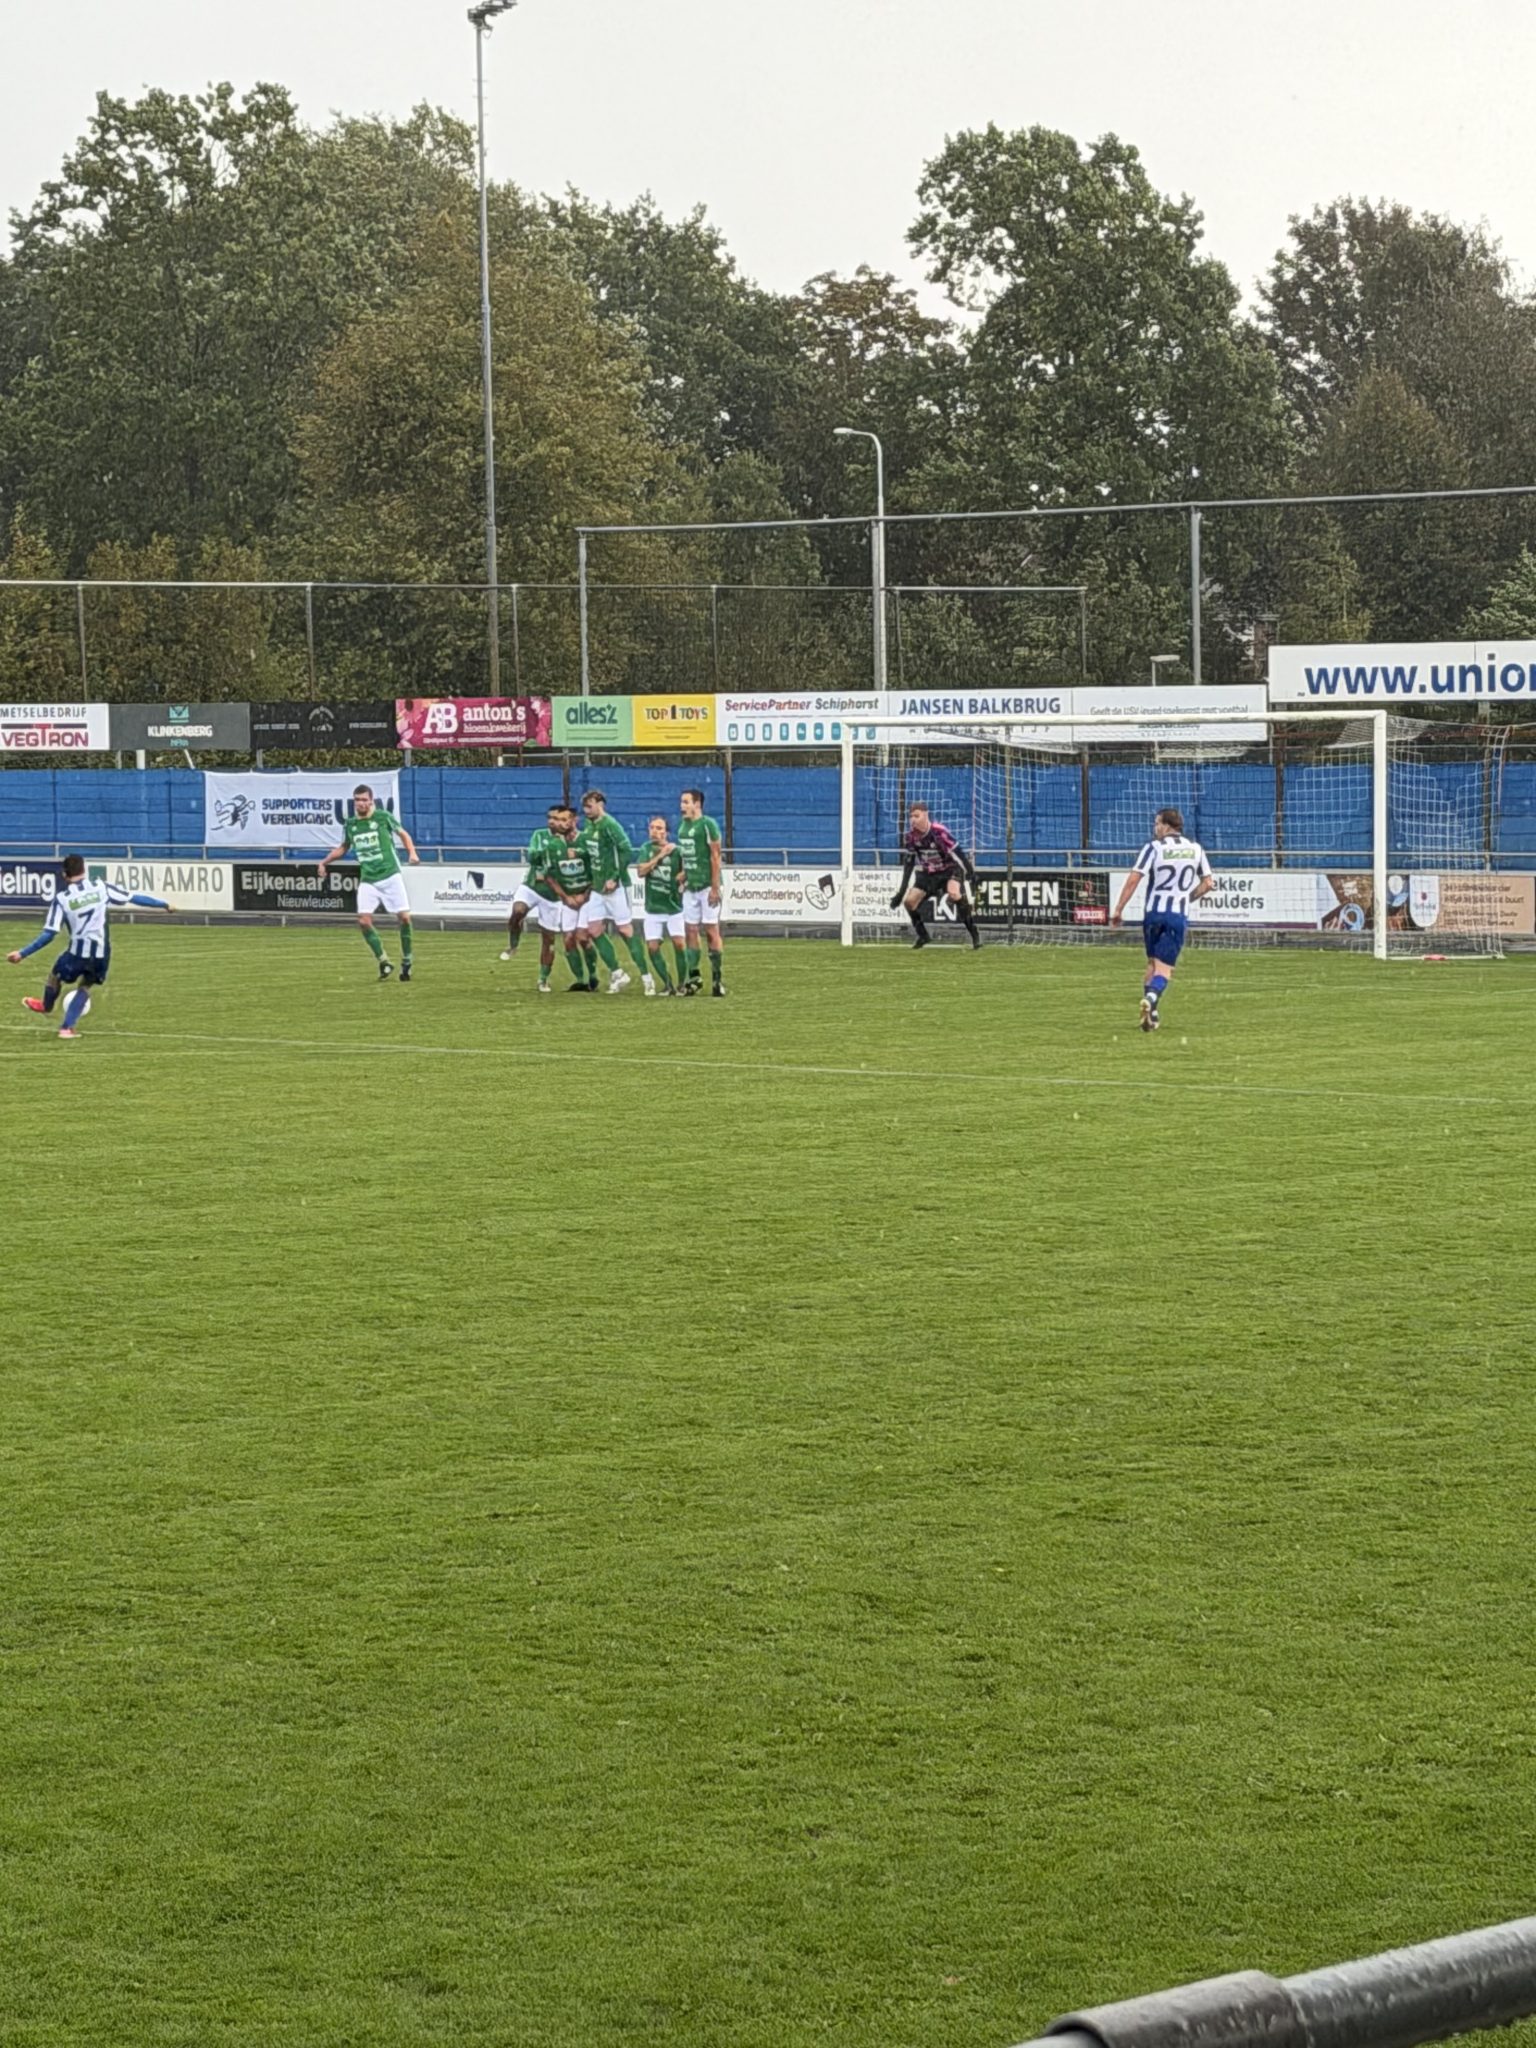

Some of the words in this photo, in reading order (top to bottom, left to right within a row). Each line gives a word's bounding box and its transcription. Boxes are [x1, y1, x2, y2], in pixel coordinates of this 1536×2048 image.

[1304, 653, 1536, 695] www.unio
[463, 700, 526, 721] anton's
[815, 698, 879, 711] Schiphorst
[899, 699, 963, 715] JANSEN
[969, 698, 1061, 714] BALKBRUG
[645, 707, 668, 720] TOP
[680, 706, 708, 720] TOYS
[1, 724, 88, 747] VEGTRON
[262, 798, 332, 811] SUPPORTERS
[262, 812, 333, 825] VERENIGING
[115, 866, 154, 890] ABN
[162, 866, 223, 892] AMRO
[241, 871, 325, 894] Eijkenaar
[733, 870, 800, 882] Schoonhoven
[1155, 864, 1196, 892] 20
[1211, 876, 1253, 891] ekker
[277, 894, 344, 908] Nieuwleusen
[730, 888, 803, 903] Automatisering
[1200, 893, 1264, 909] mulders
[77, 908, 95, 935] 7
